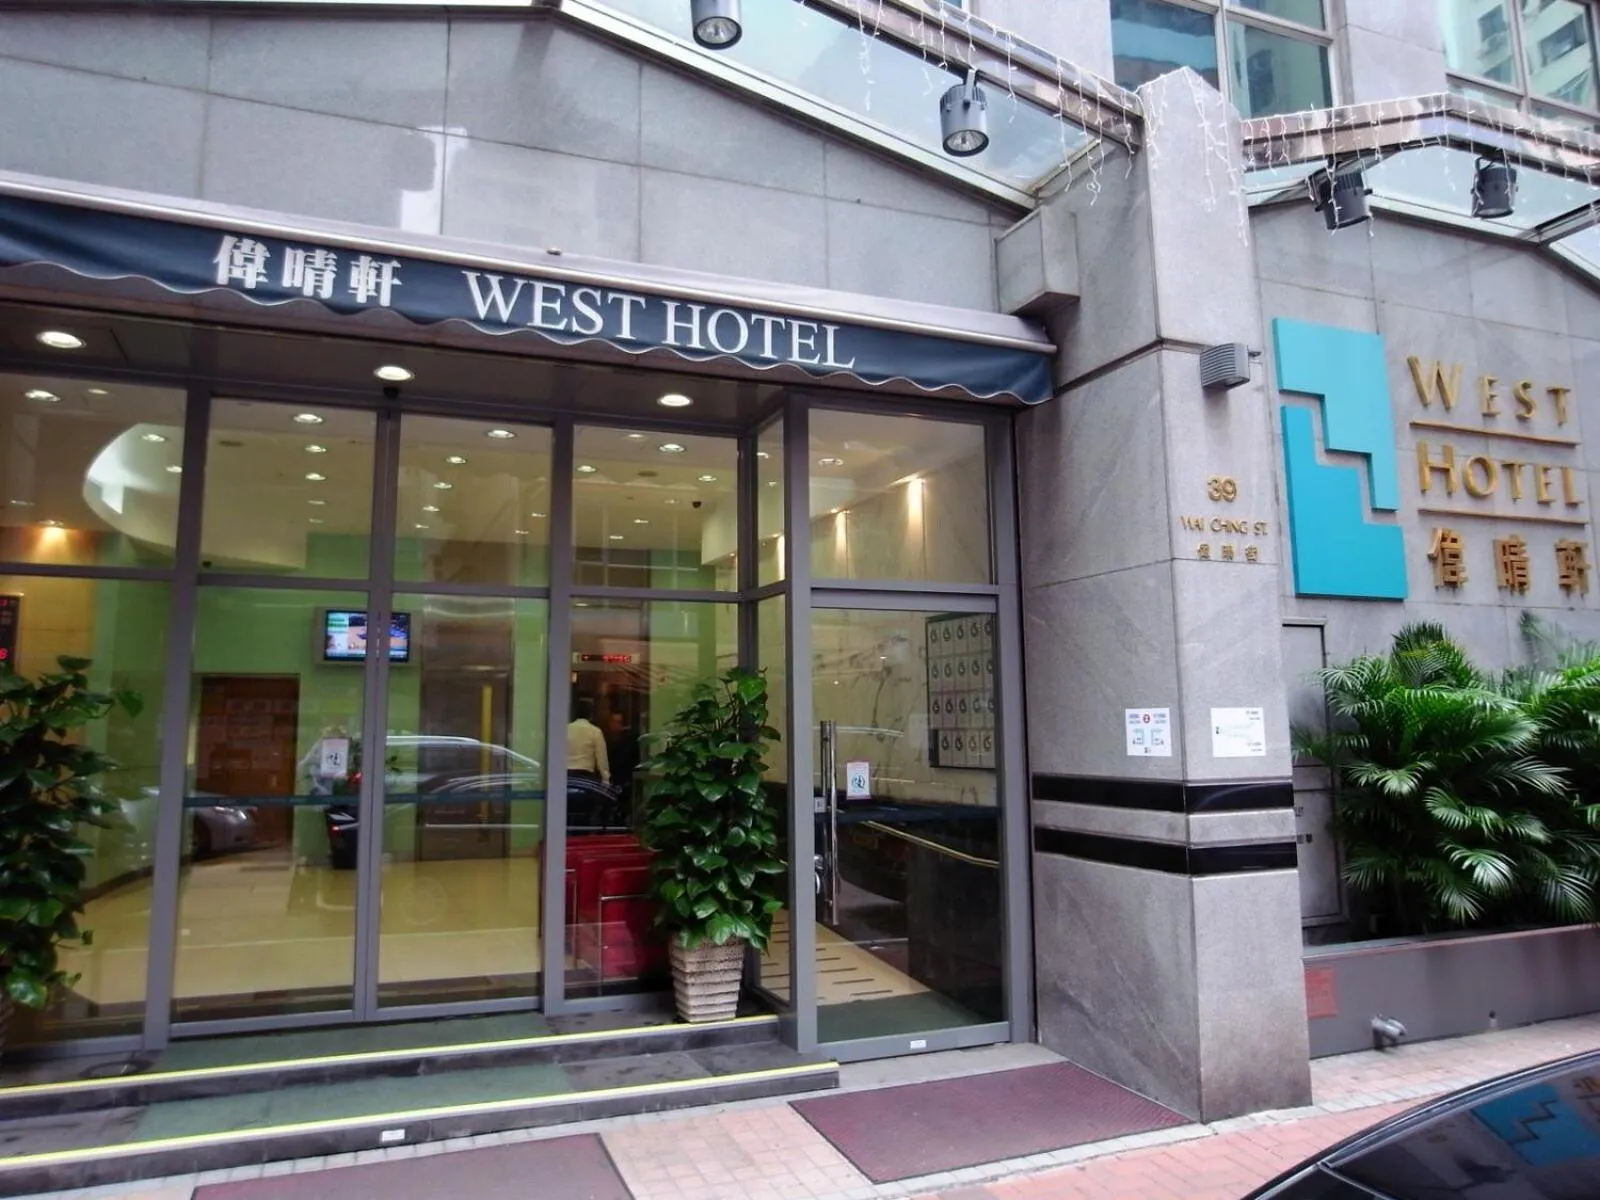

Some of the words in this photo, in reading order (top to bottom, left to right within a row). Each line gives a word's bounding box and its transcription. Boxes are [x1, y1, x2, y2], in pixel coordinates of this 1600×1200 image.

[213, 234, 402, 307] 偉晴軒
[461, 270, 645, 340] WEST
[661, 300, 856, 370] HOTEL
[1407, 355, 1571, 426] WEST
[1207, 477, 1238, 503] 39
[1416, 440, 1583, 506] HOTEL
[1210, 516, 1248, 535] CHING
